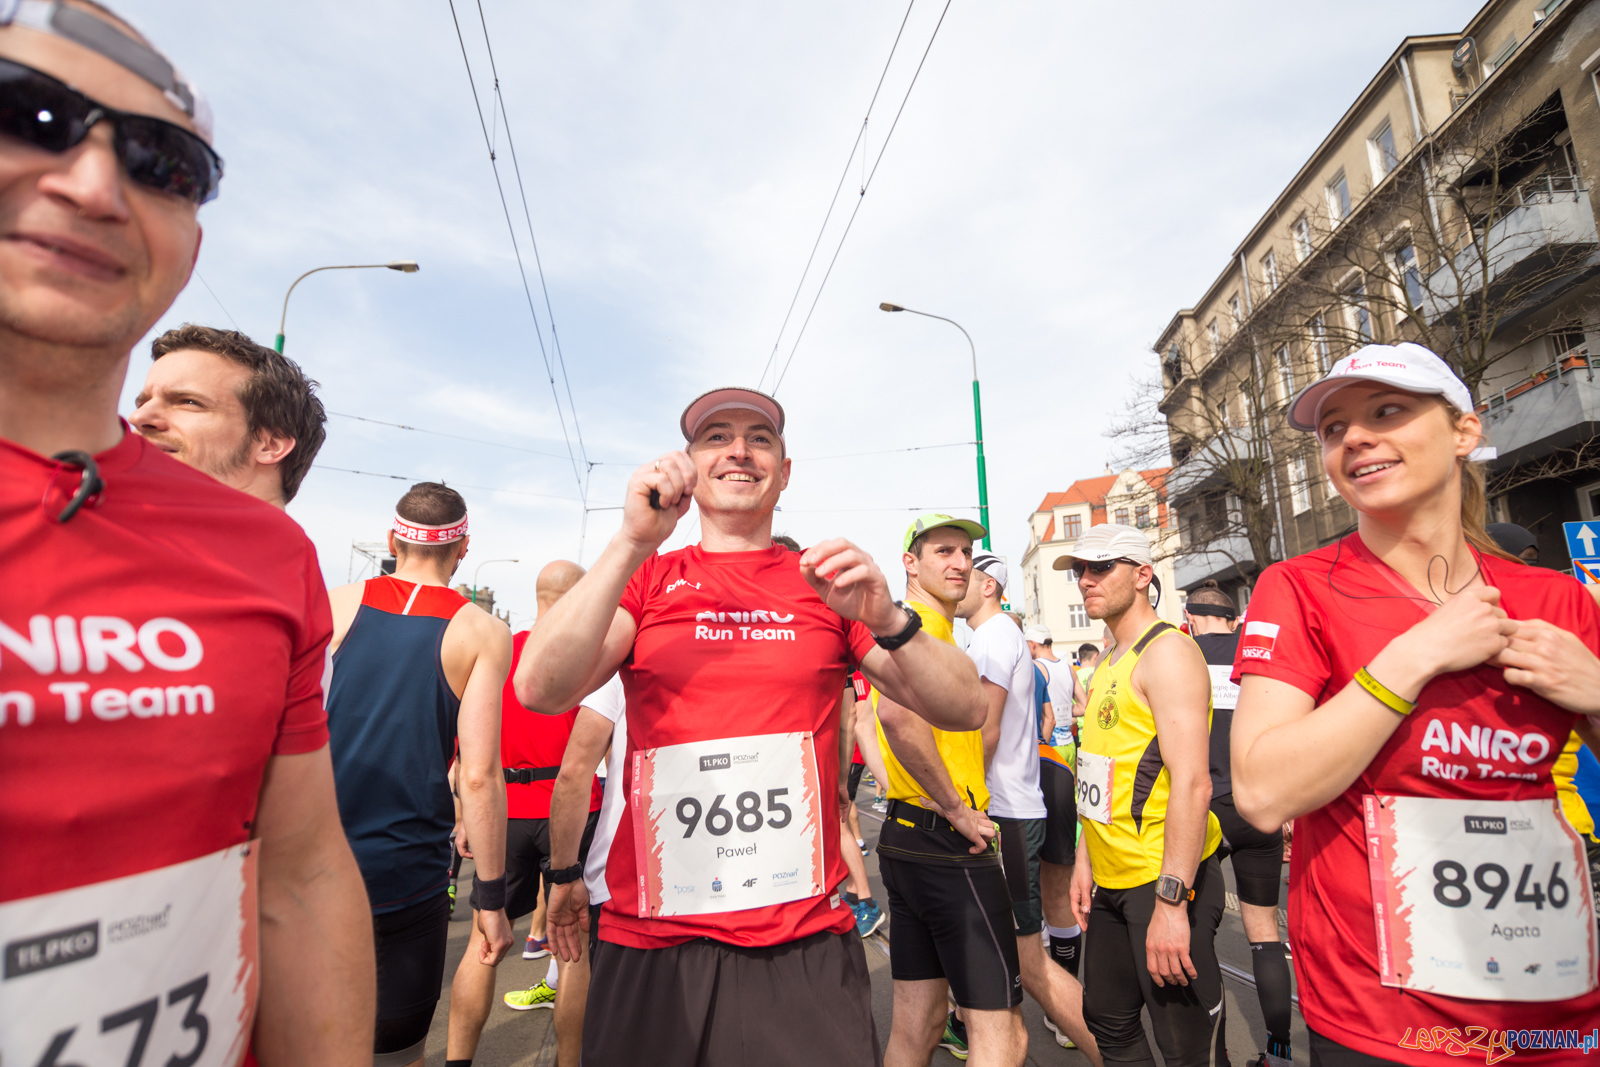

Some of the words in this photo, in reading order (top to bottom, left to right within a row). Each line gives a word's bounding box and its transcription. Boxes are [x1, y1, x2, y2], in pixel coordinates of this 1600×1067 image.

[1376, 361, 1407, 369] Team
[695, 625, 733, 640] Run
[738, 626, 796, 641] Team
[48, 681, 216, 724] Team
[1421, 718, 1550, 765] ANIRO
[1421, 756, 1469, 780] Run
[675, 787, 793, 839] 9685
[716, 842, 757, 859] Paweł
[1433, 860, 1569, 910] 8946
[1490, 923, 1541, 941] Agata
